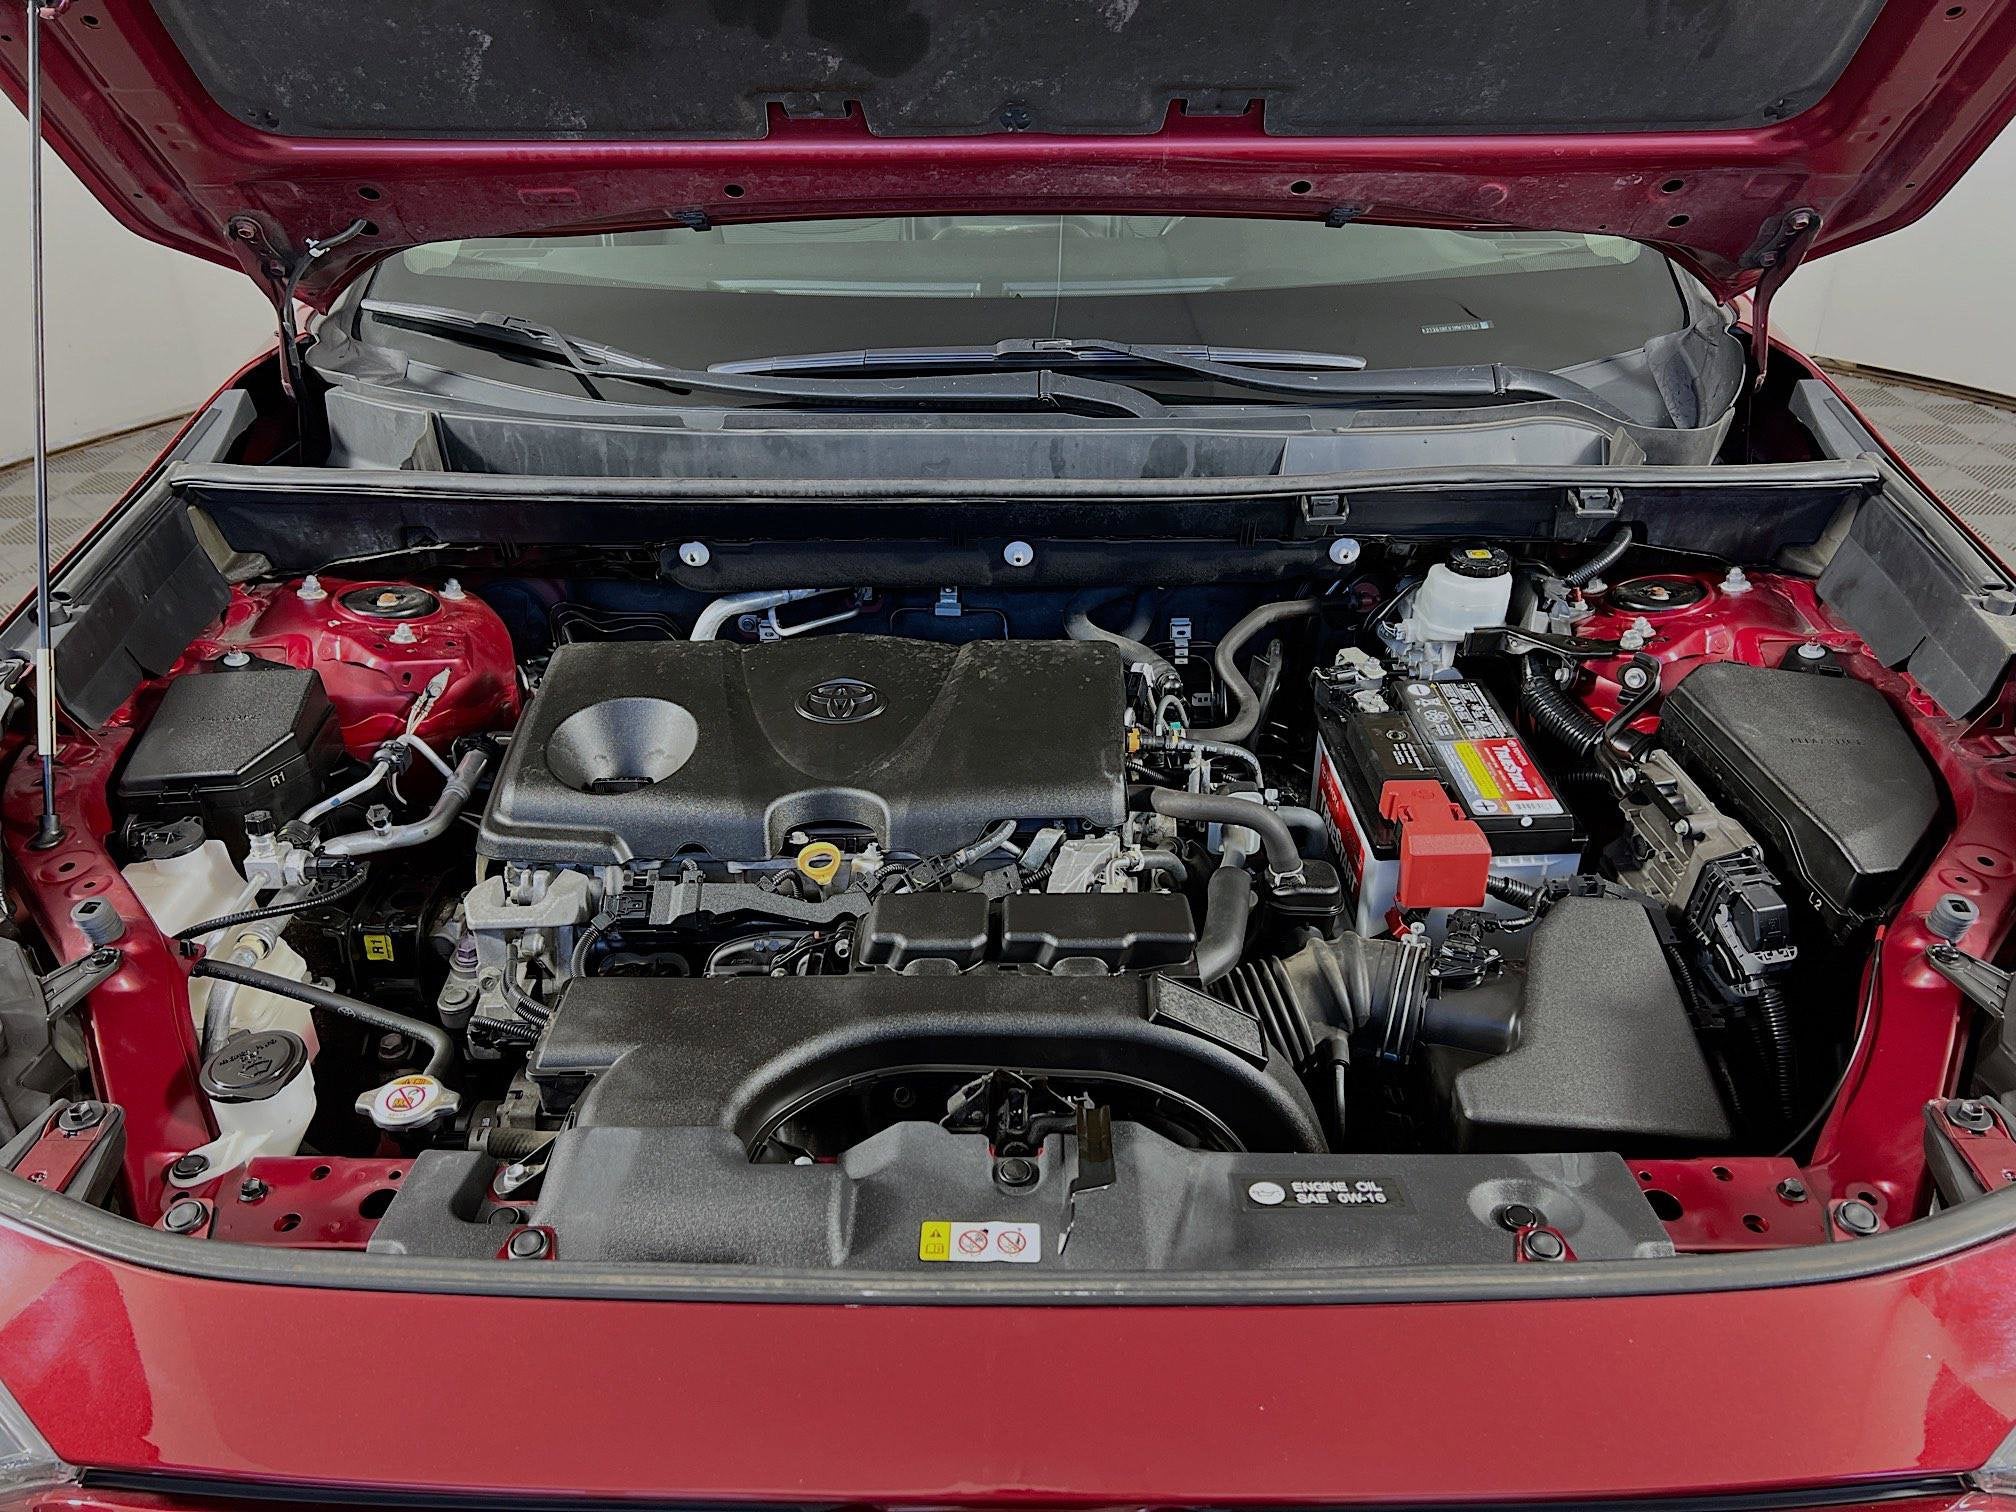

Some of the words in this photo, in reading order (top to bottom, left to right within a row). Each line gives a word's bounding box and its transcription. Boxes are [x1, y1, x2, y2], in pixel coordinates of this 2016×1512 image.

[269, 771, 286, 788] R1
[1320, 788, 1359, 893] TRUESTART
[1808, 891, 1822, 911] L2
[370, 940, 385, 954] R1
[1291, 1181, 1348, 1193] ENGINE
[1355, 1181, 1383, 1192] OIL
[1296, 1193, 1329, 1204] SAE
